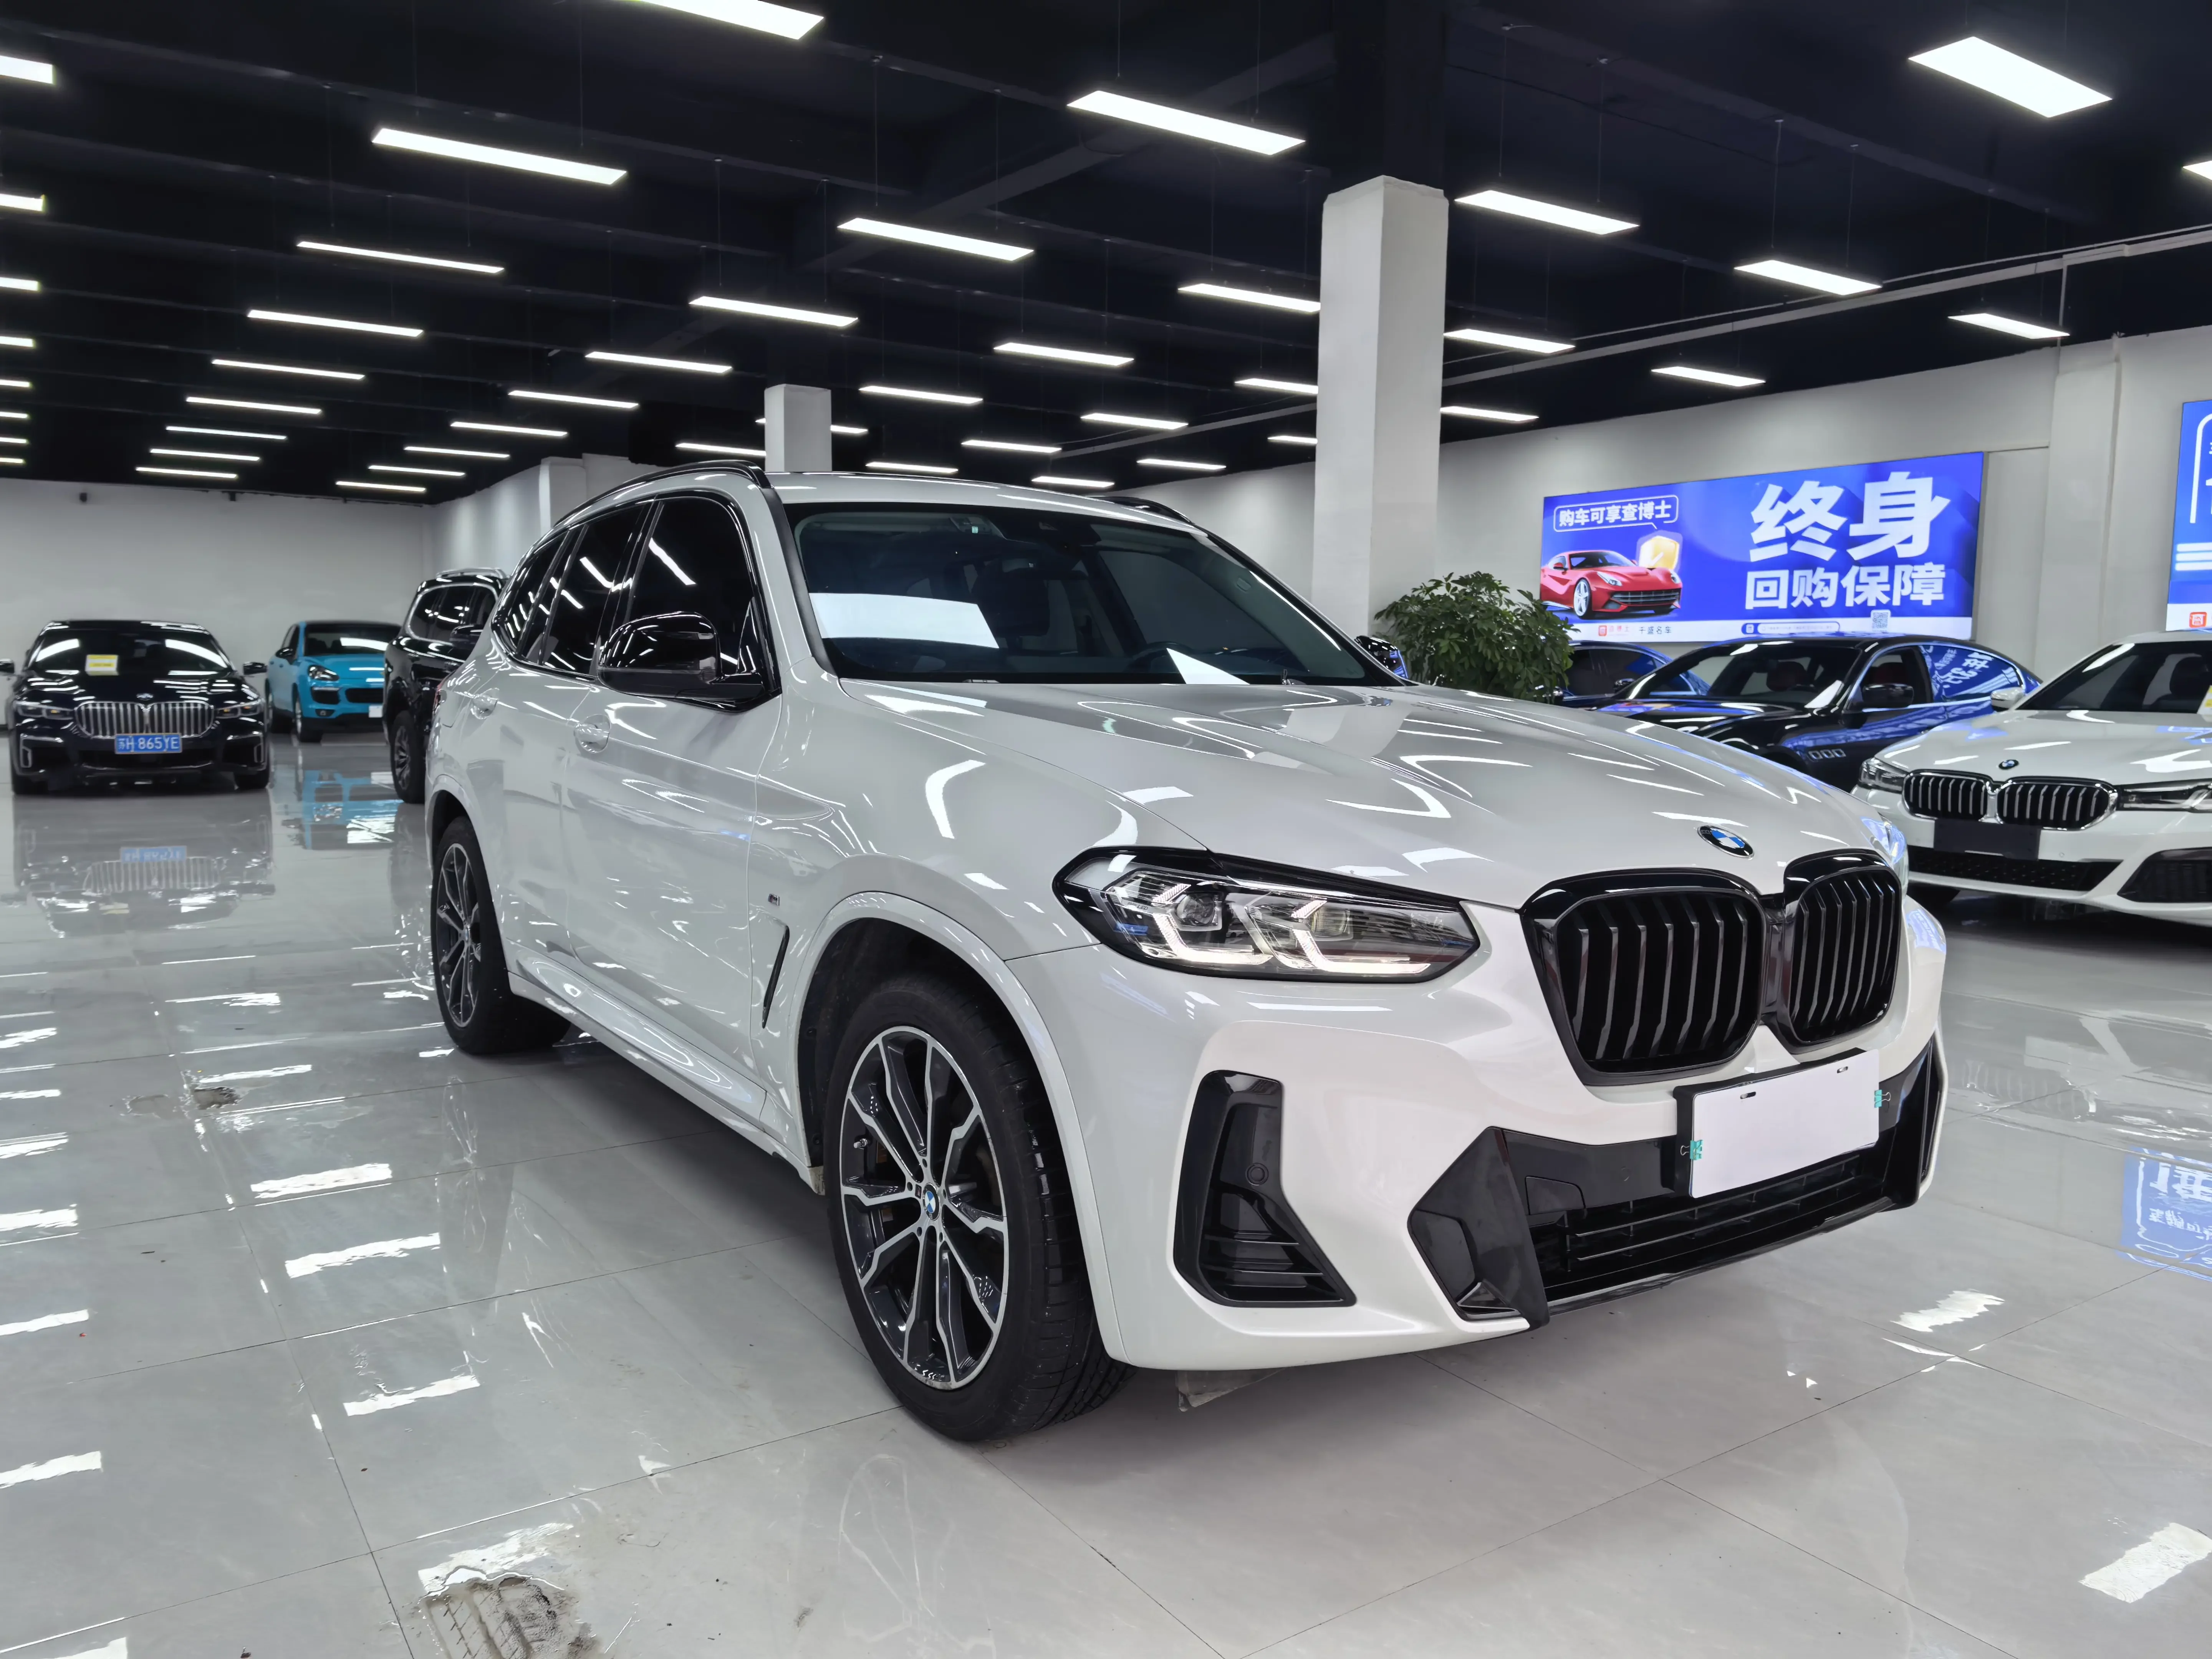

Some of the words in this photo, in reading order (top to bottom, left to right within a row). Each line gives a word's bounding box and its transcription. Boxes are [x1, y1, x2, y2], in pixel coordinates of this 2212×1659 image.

[1559, 500, 1672, 527] 购车可享查博士
[1749, 472, 1951, 562] 终身
[1745, 562, 1945, 609] 回购保障
